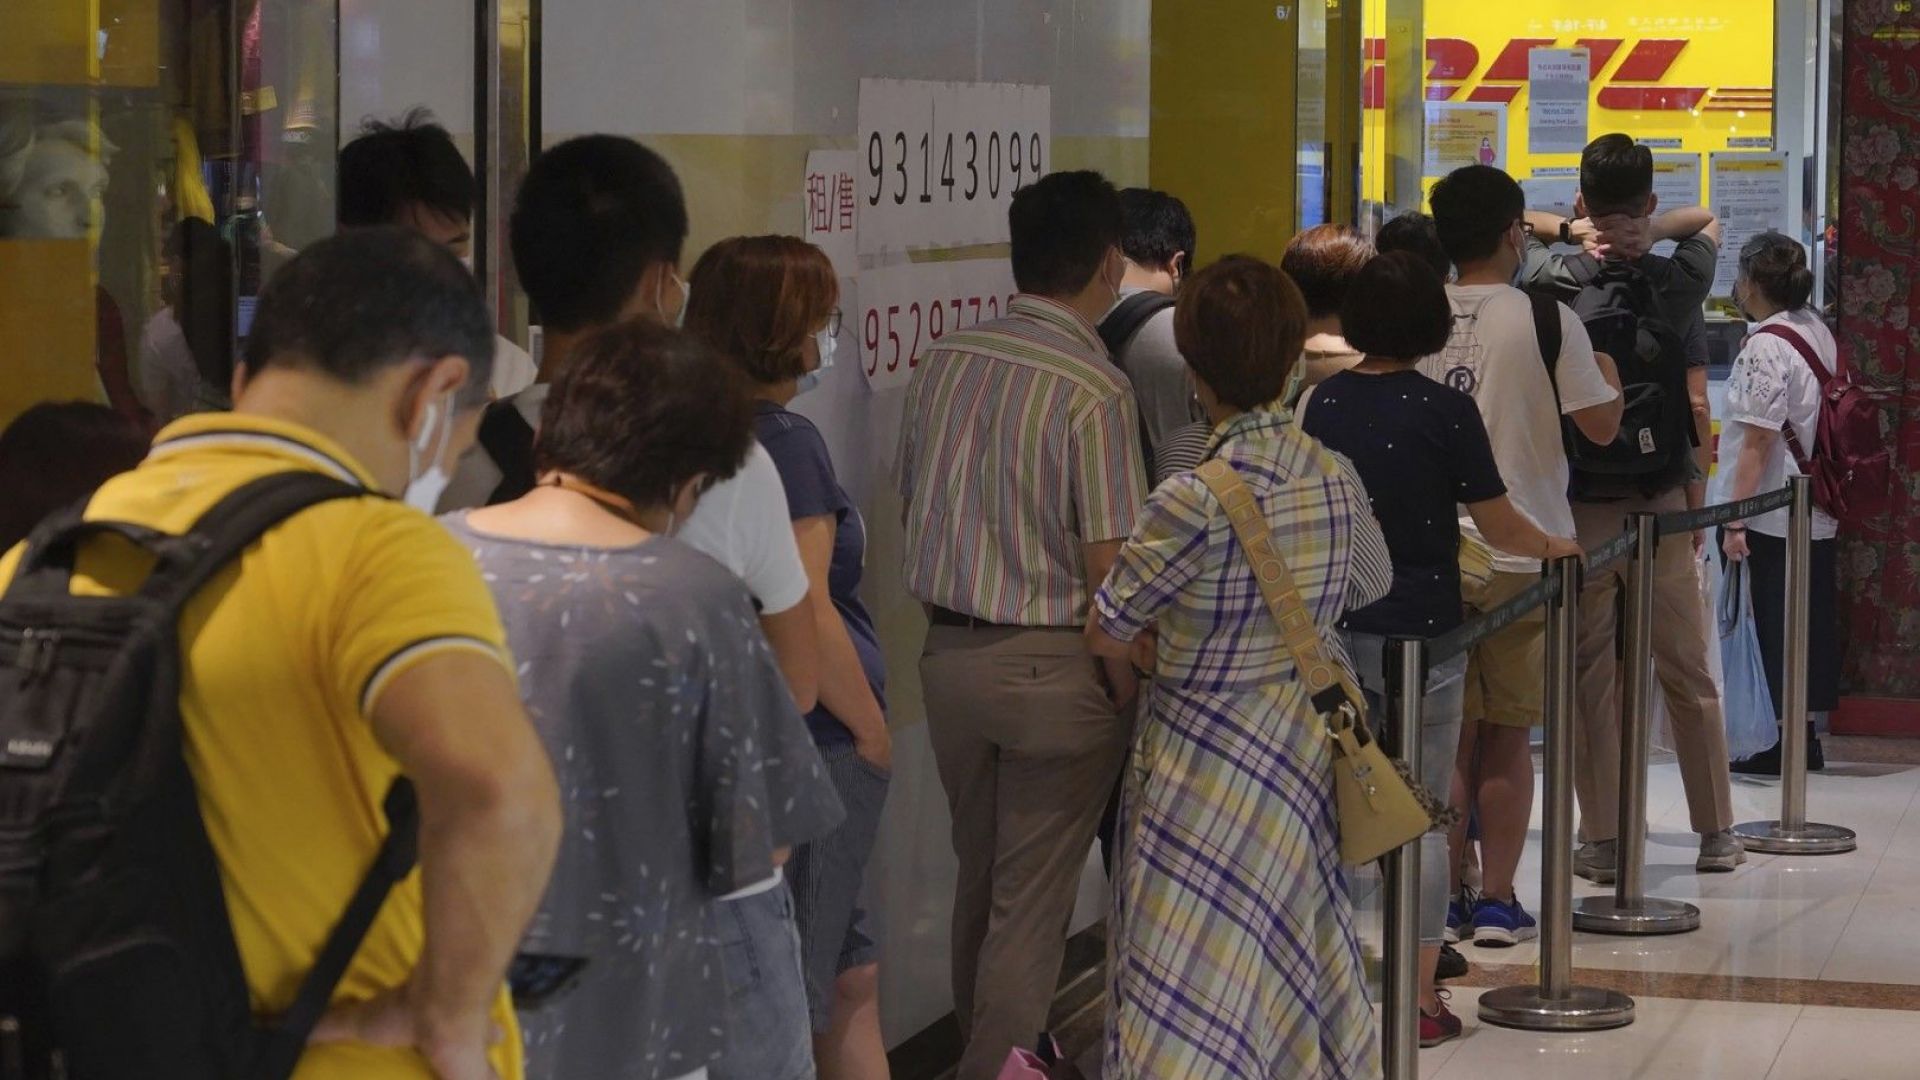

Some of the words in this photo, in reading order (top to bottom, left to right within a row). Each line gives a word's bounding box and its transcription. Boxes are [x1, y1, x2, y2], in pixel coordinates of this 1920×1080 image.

[1364, 38, 1710, 111] DHL
[807, 172, 854, 233] 租/售
[868, 131, 1041, 206] 93143099
